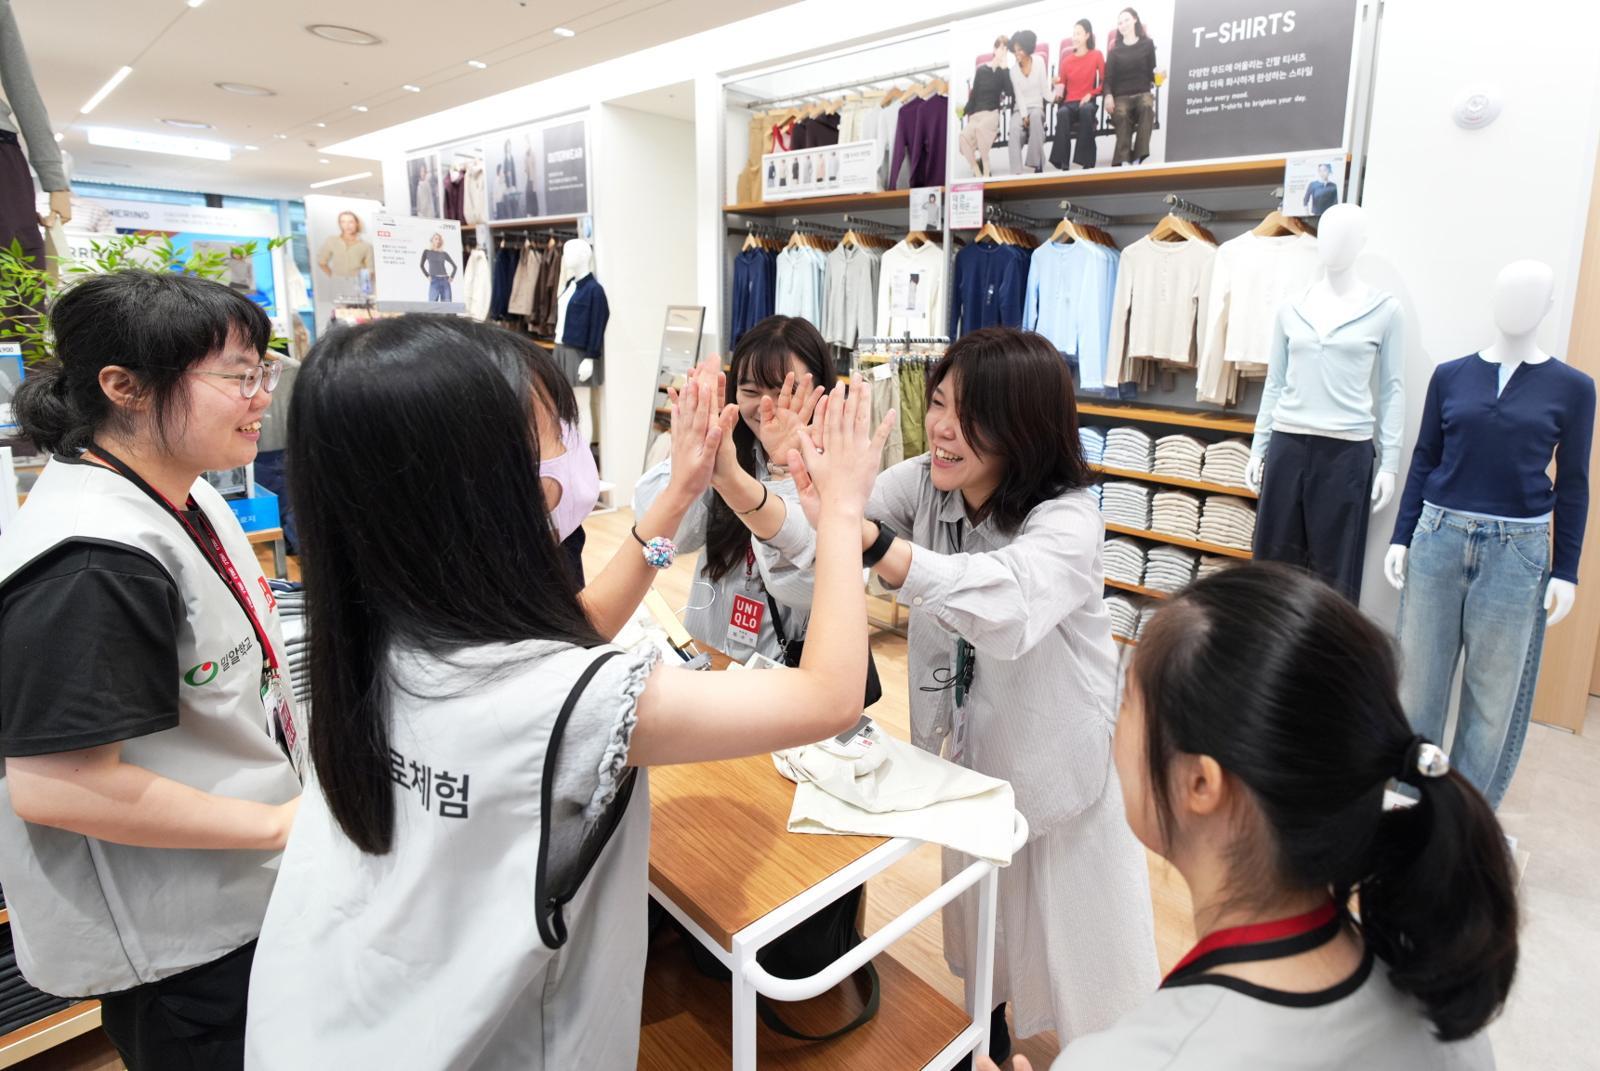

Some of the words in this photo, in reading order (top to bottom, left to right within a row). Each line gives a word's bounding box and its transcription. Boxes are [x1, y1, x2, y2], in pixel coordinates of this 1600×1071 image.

[1192, 10, 1296, 48] T-SHIRTS
[1211, 63, 1233, 75] 무드에
[1288, 66, 1313, 77] 스타일
[1252, 99, 1277, 108] brighten
[1278, 97, 1292, 105] your
[736, 599, 758, 617] UNI
[734, 612, 757, 629] QLO
[220, 636, 253, 672] 밀알학교
